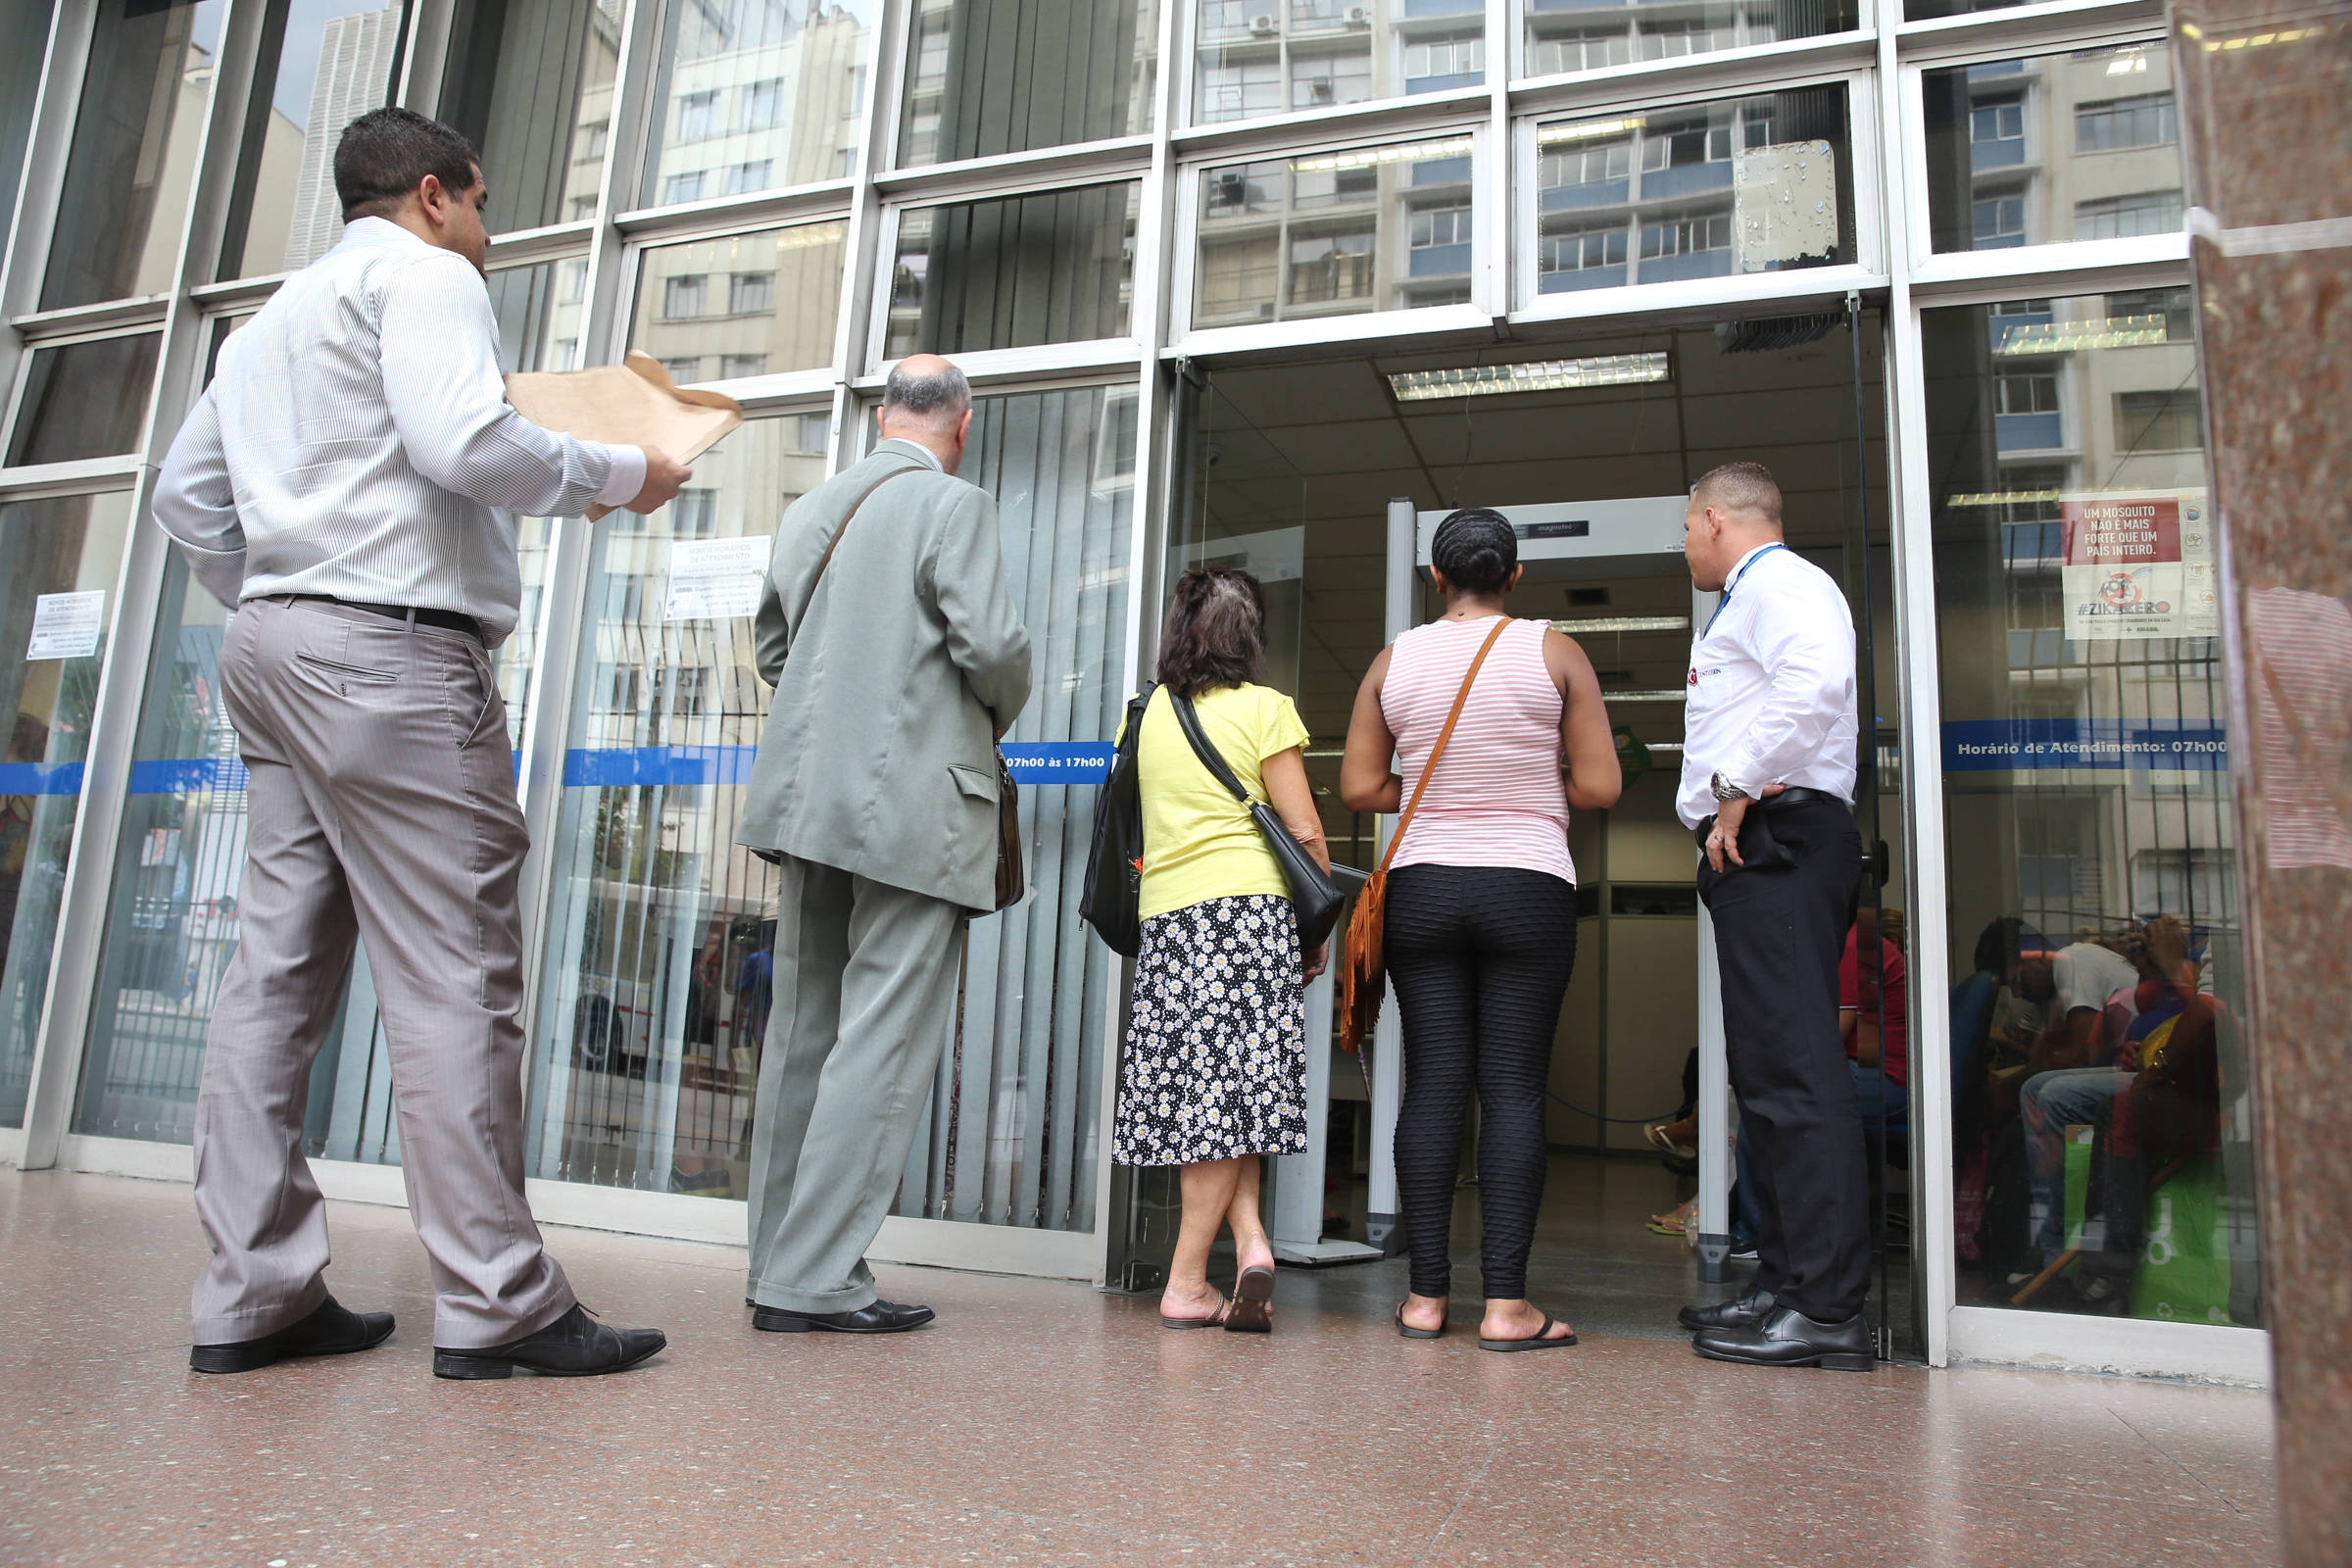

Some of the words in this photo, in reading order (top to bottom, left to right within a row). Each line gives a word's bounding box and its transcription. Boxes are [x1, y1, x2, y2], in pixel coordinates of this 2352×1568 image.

[2084, 508, 2100, 518] UM
[2103, 506, 2155, 518] MOSQUITO
[2091, 518, 2112, 531] NÃO
[2115, 517, 2122, 530] É
[2124, 518, 2149, 529] MAIS
[2084, 532, 2116, 544] FORTE
[2119, 531, 2138, 543] QUE
[2141, 531, 2157, 542] UM
[2086, 544, 2110, 557] PAÍS
[2113, 544, 2156, 556] INTEIRO.
[2077, 601, 2171, 615] #ZIKAZERO
[1958, 742, 2019, 755] Horário
[2024, 743, 2044, 754] de
[2049, 741, 2166, 754] Atendimento:
[2172, 741, 2227, 753] 07h00
[1006, 758, 1045, 767] 07h00
[1049, 757, 1061, 767] às
[1066, 758, 1105, 767] 17h00
